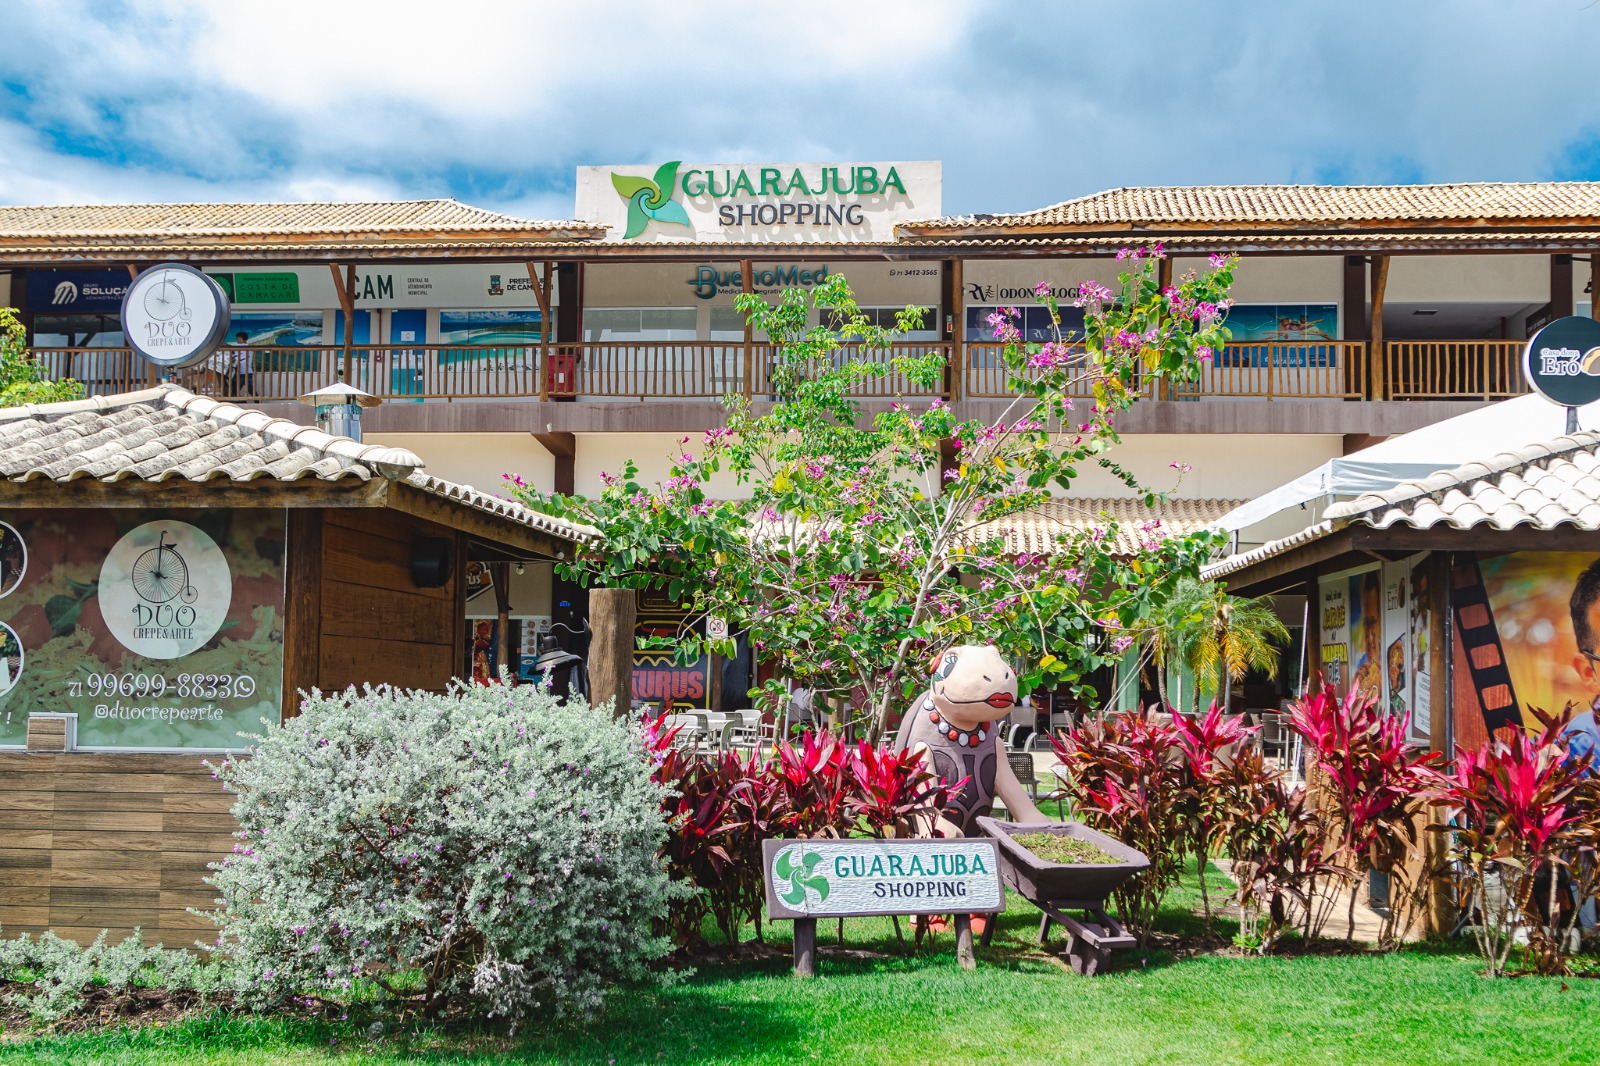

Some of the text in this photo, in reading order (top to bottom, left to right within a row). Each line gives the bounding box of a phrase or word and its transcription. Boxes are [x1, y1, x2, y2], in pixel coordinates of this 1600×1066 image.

[681, 166, 907, 197] GUARAJUBA
[718, 203, 864, 227] SHOPPING
[82, 286, 127, 296] SOLUÇÃ
[688, 264, 829, 300] BuenoMed
[144, 321, 192, 338] DUO
[147, 337, 192, 347] CREPE&ARTE
[1541, 347, 1580, 357] Casa dona
[1539, 356, 1581, 376] Eró
[132, 603, 197, 628] DUO
[133, 627, 194, 640] CREPE&ARTE
[68, 672, 233, 698] 71 99699-8833
[834, 853, 988, 877] GUARAJUBA
[872, 881, 967, 898] SHOPPING
